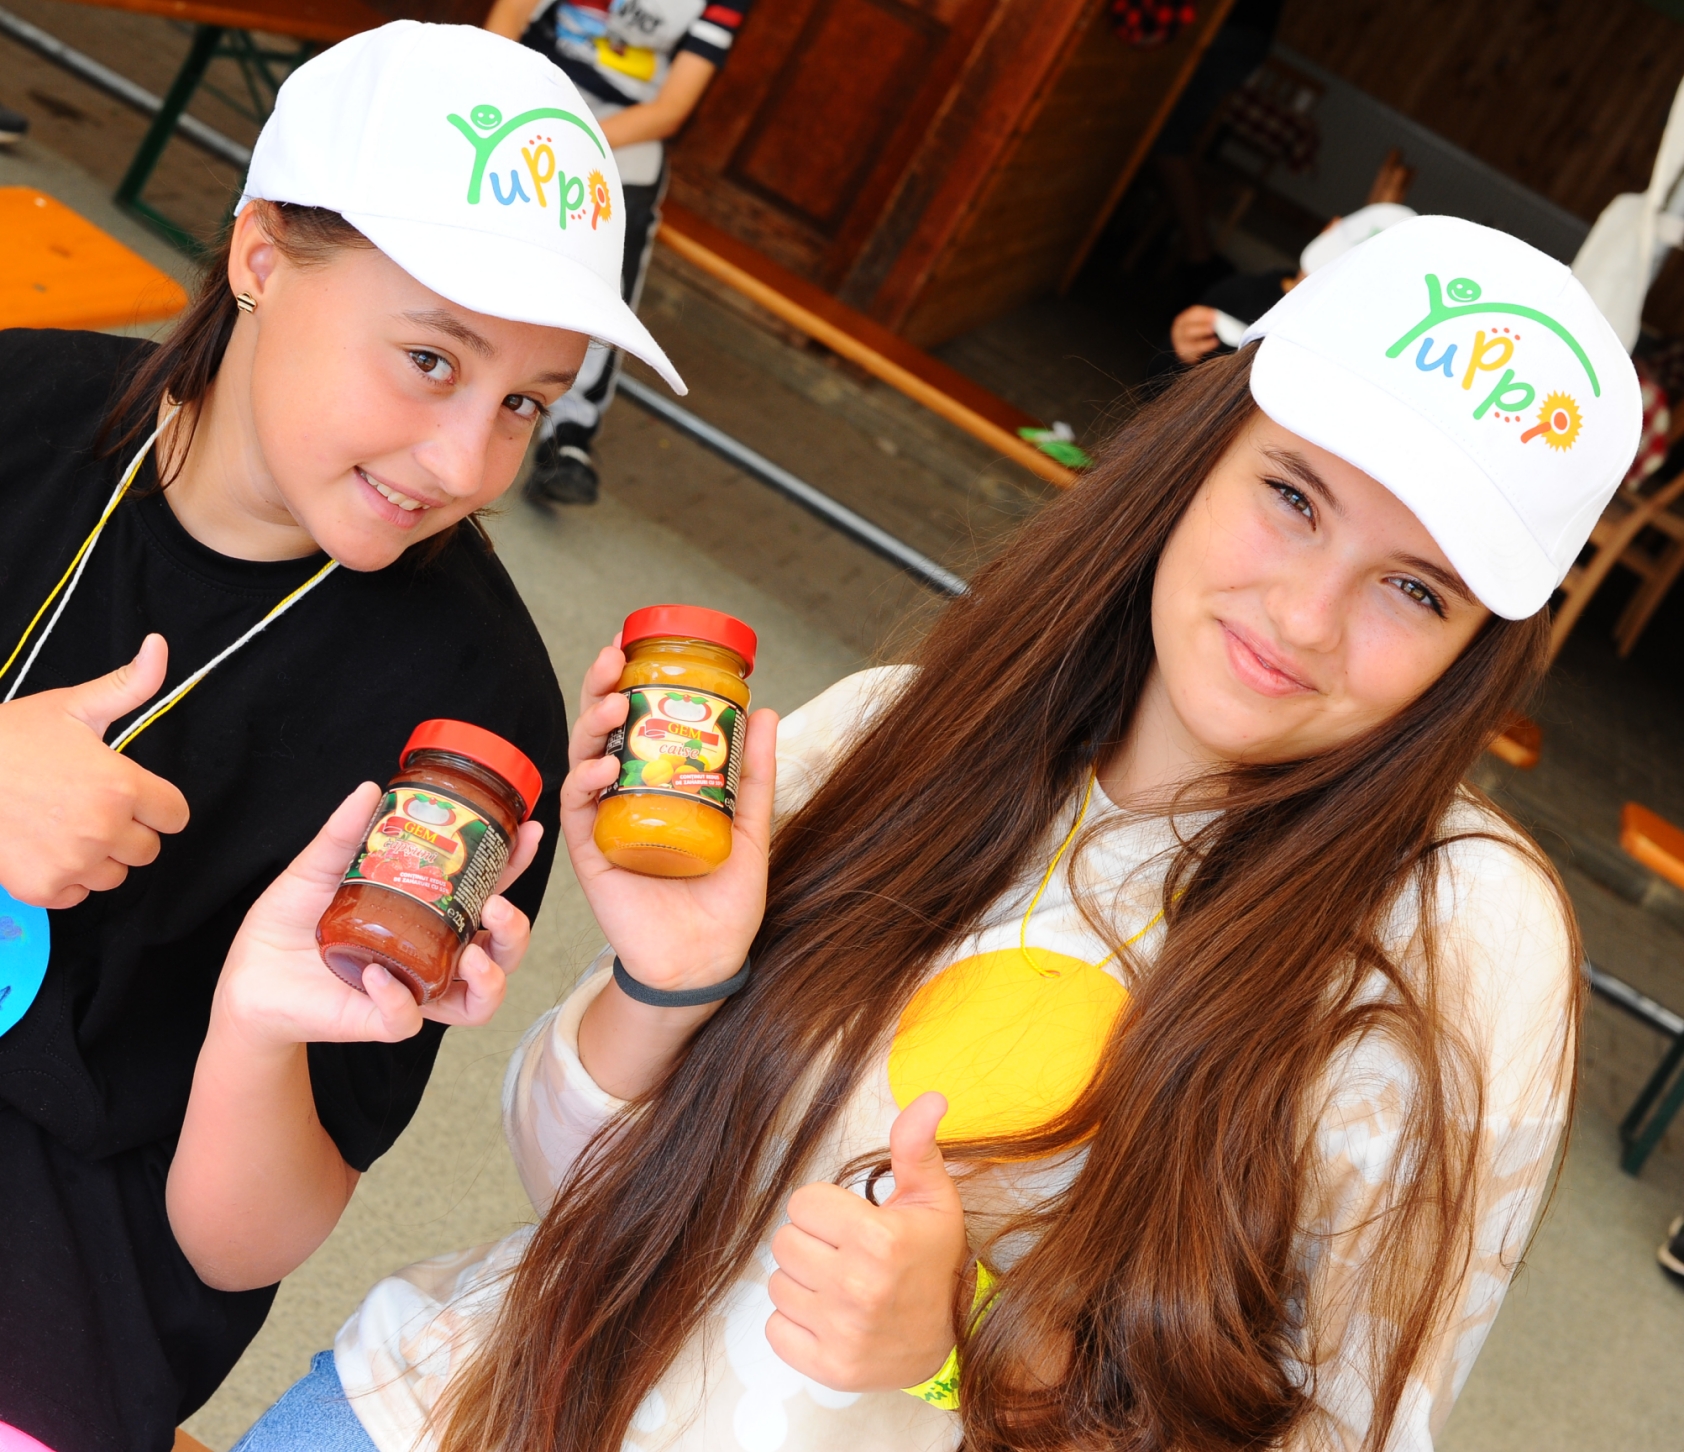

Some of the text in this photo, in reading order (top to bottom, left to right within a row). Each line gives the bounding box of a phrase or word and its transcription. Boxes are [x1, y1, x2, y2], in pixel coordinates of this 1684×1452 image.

[667, 722, 702, 740] GEM
[659, 742, 700, 760] caise
[404, 821, 439, 844] GEM
[431, 882, 439, 890] CU
